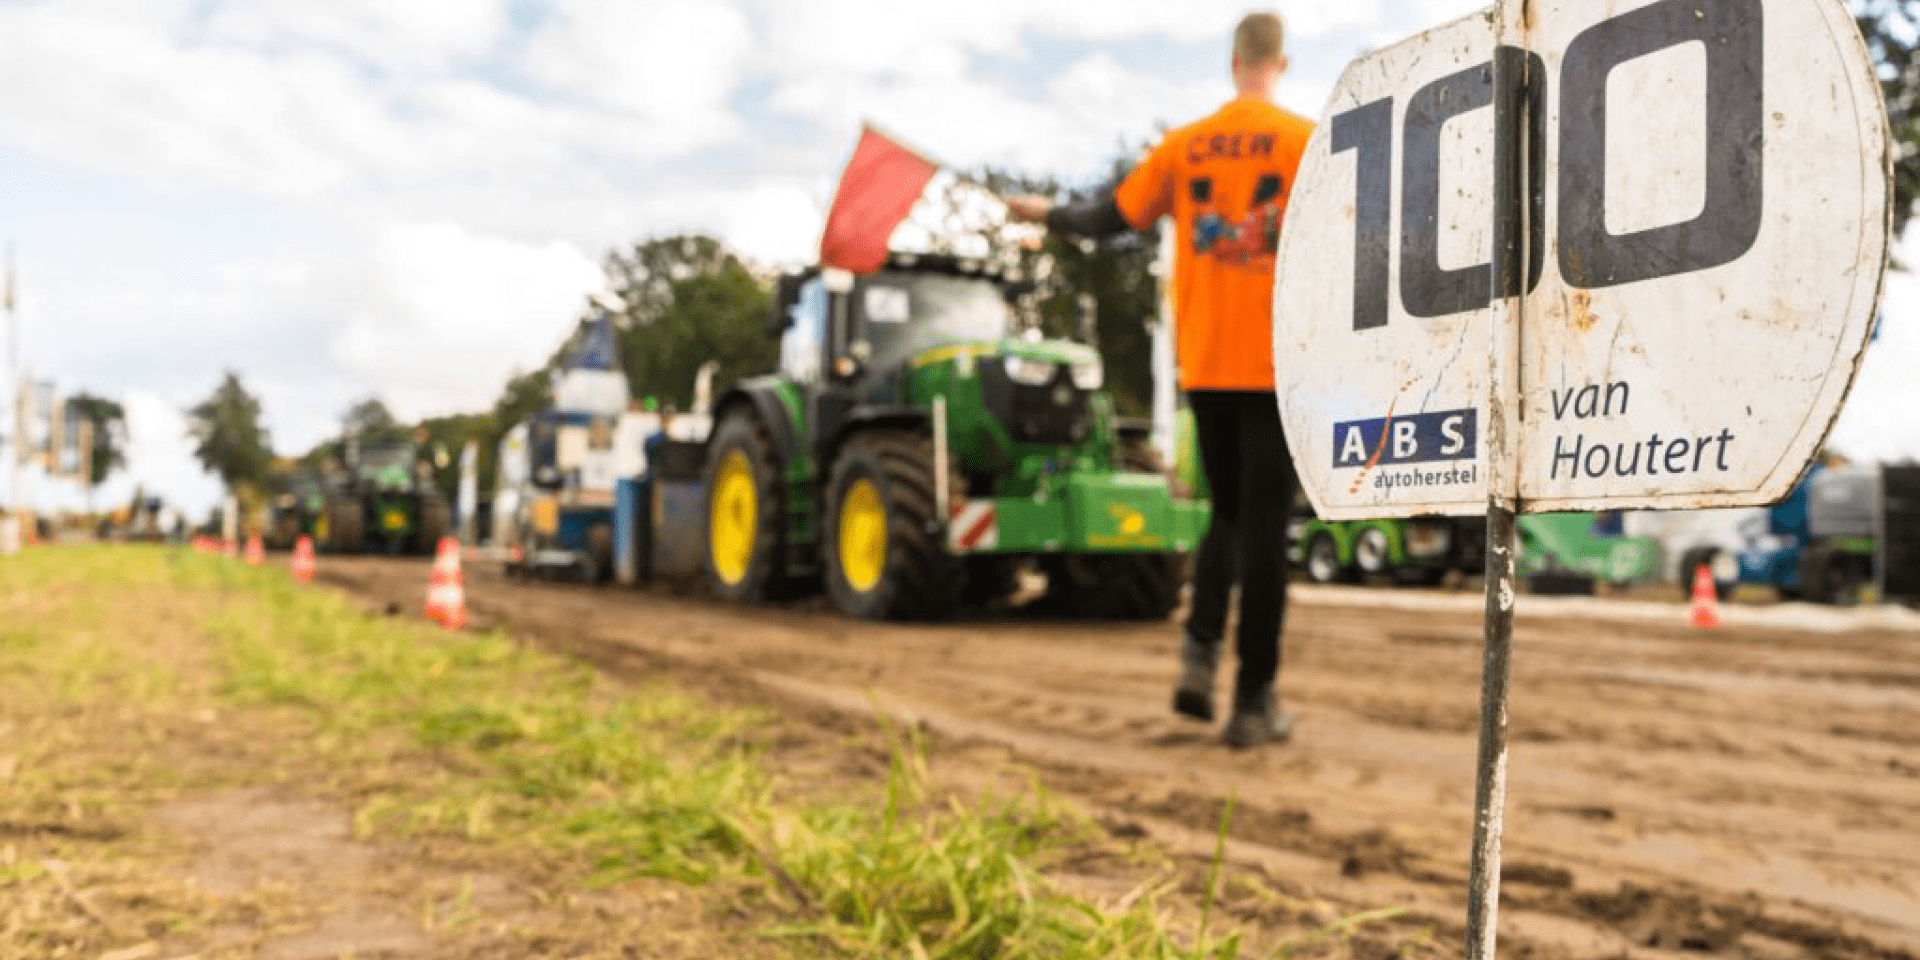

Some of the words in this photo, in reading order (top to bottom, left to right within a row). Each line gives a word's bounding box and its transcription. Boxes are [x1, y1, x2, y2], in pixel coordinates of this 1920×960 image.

[1186, 132, 1277, 165] CREW
[1331, 0, 1763, 331] 100
[1551, 380, 1630, 421] van
[1340, 415, 1465, 463] ABS
[1550, 427, 1735, 480] Houtert
[1374, 463, 1477, 488] autoherstel
